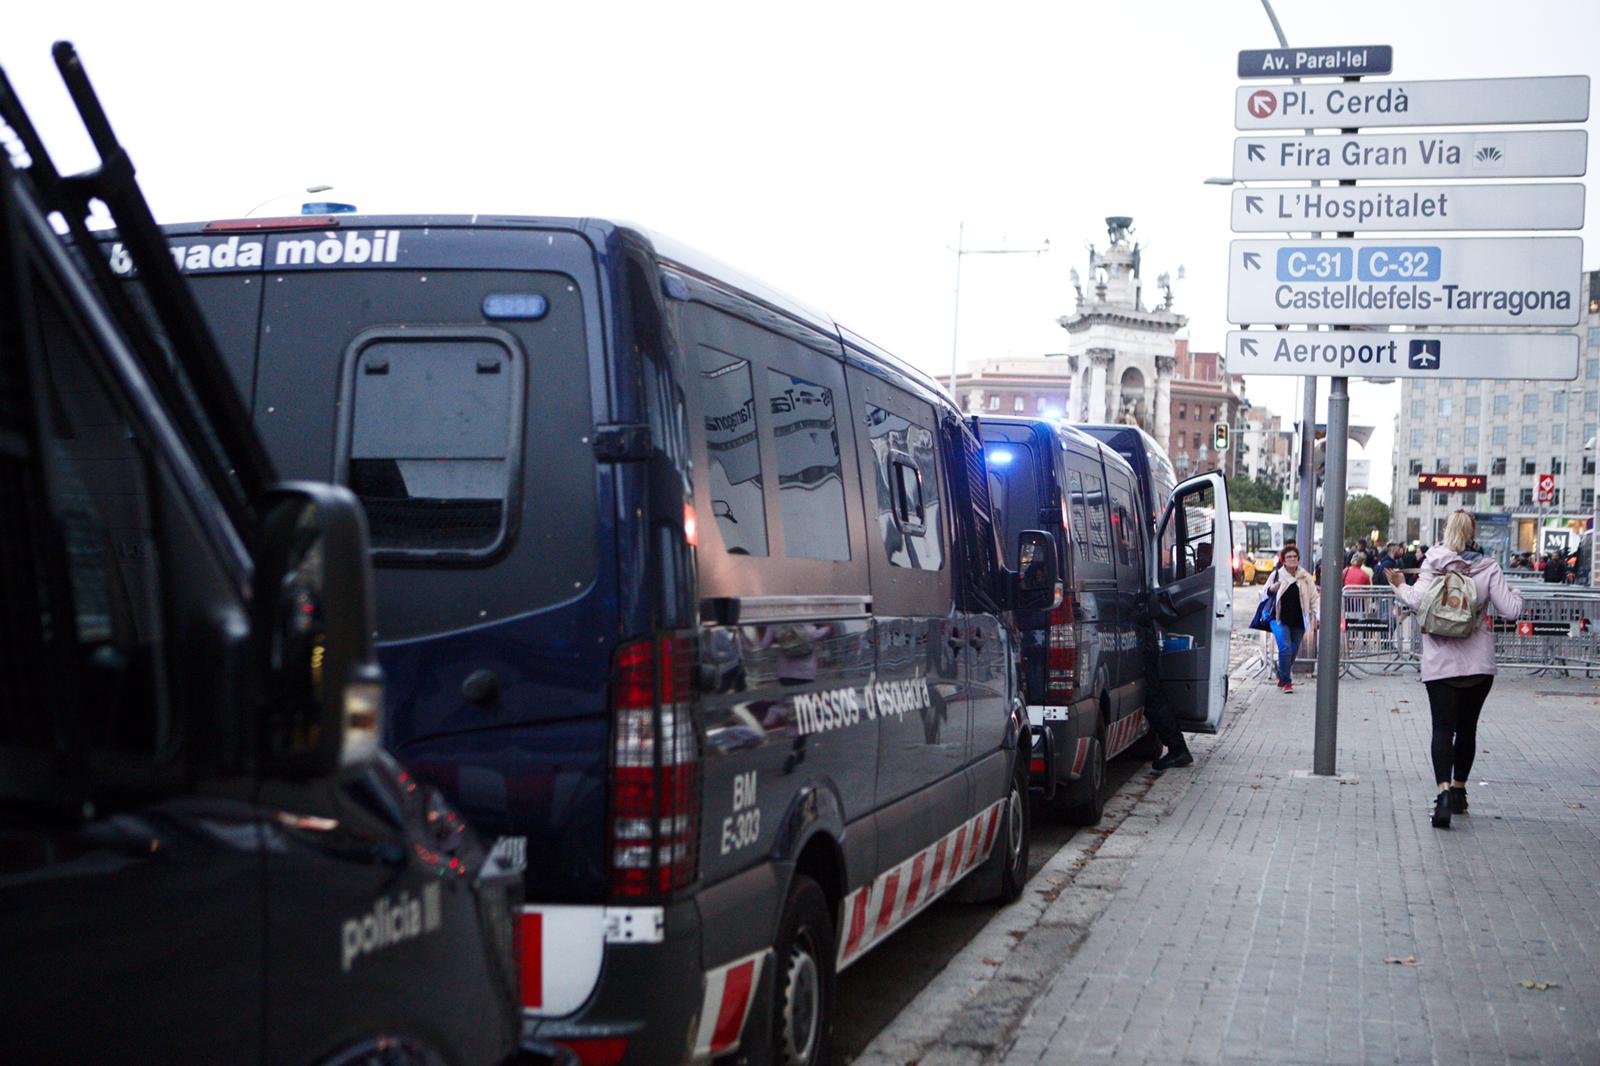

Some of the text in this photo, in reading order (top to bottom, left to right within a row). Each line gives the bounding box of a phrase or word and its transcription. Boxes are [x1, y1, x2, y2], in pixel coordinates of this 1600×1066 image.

[1262, 50, 1367, 71] Av. Paral·lel
[1282, 87, 1409, 115] Pl. Cerdà
[1280, 140, 1461, 167] Fira Gran Via
[1278, 193, 1448, 222] L'Hospitalet
[275, 230, 400, 265] mòbil
[1287, 251, 1429, 278] C-31 C-32
[1275, 284, 1571, 316] Castelldefels-Tarragona
[1273, 337, 1397, 368] Aeroport
[793, 686, 860, 736] mossos
[733, 770, 758, 813] BM
[721, 807, 760, 856] E-303
[341, 890, 420, 974] policia
